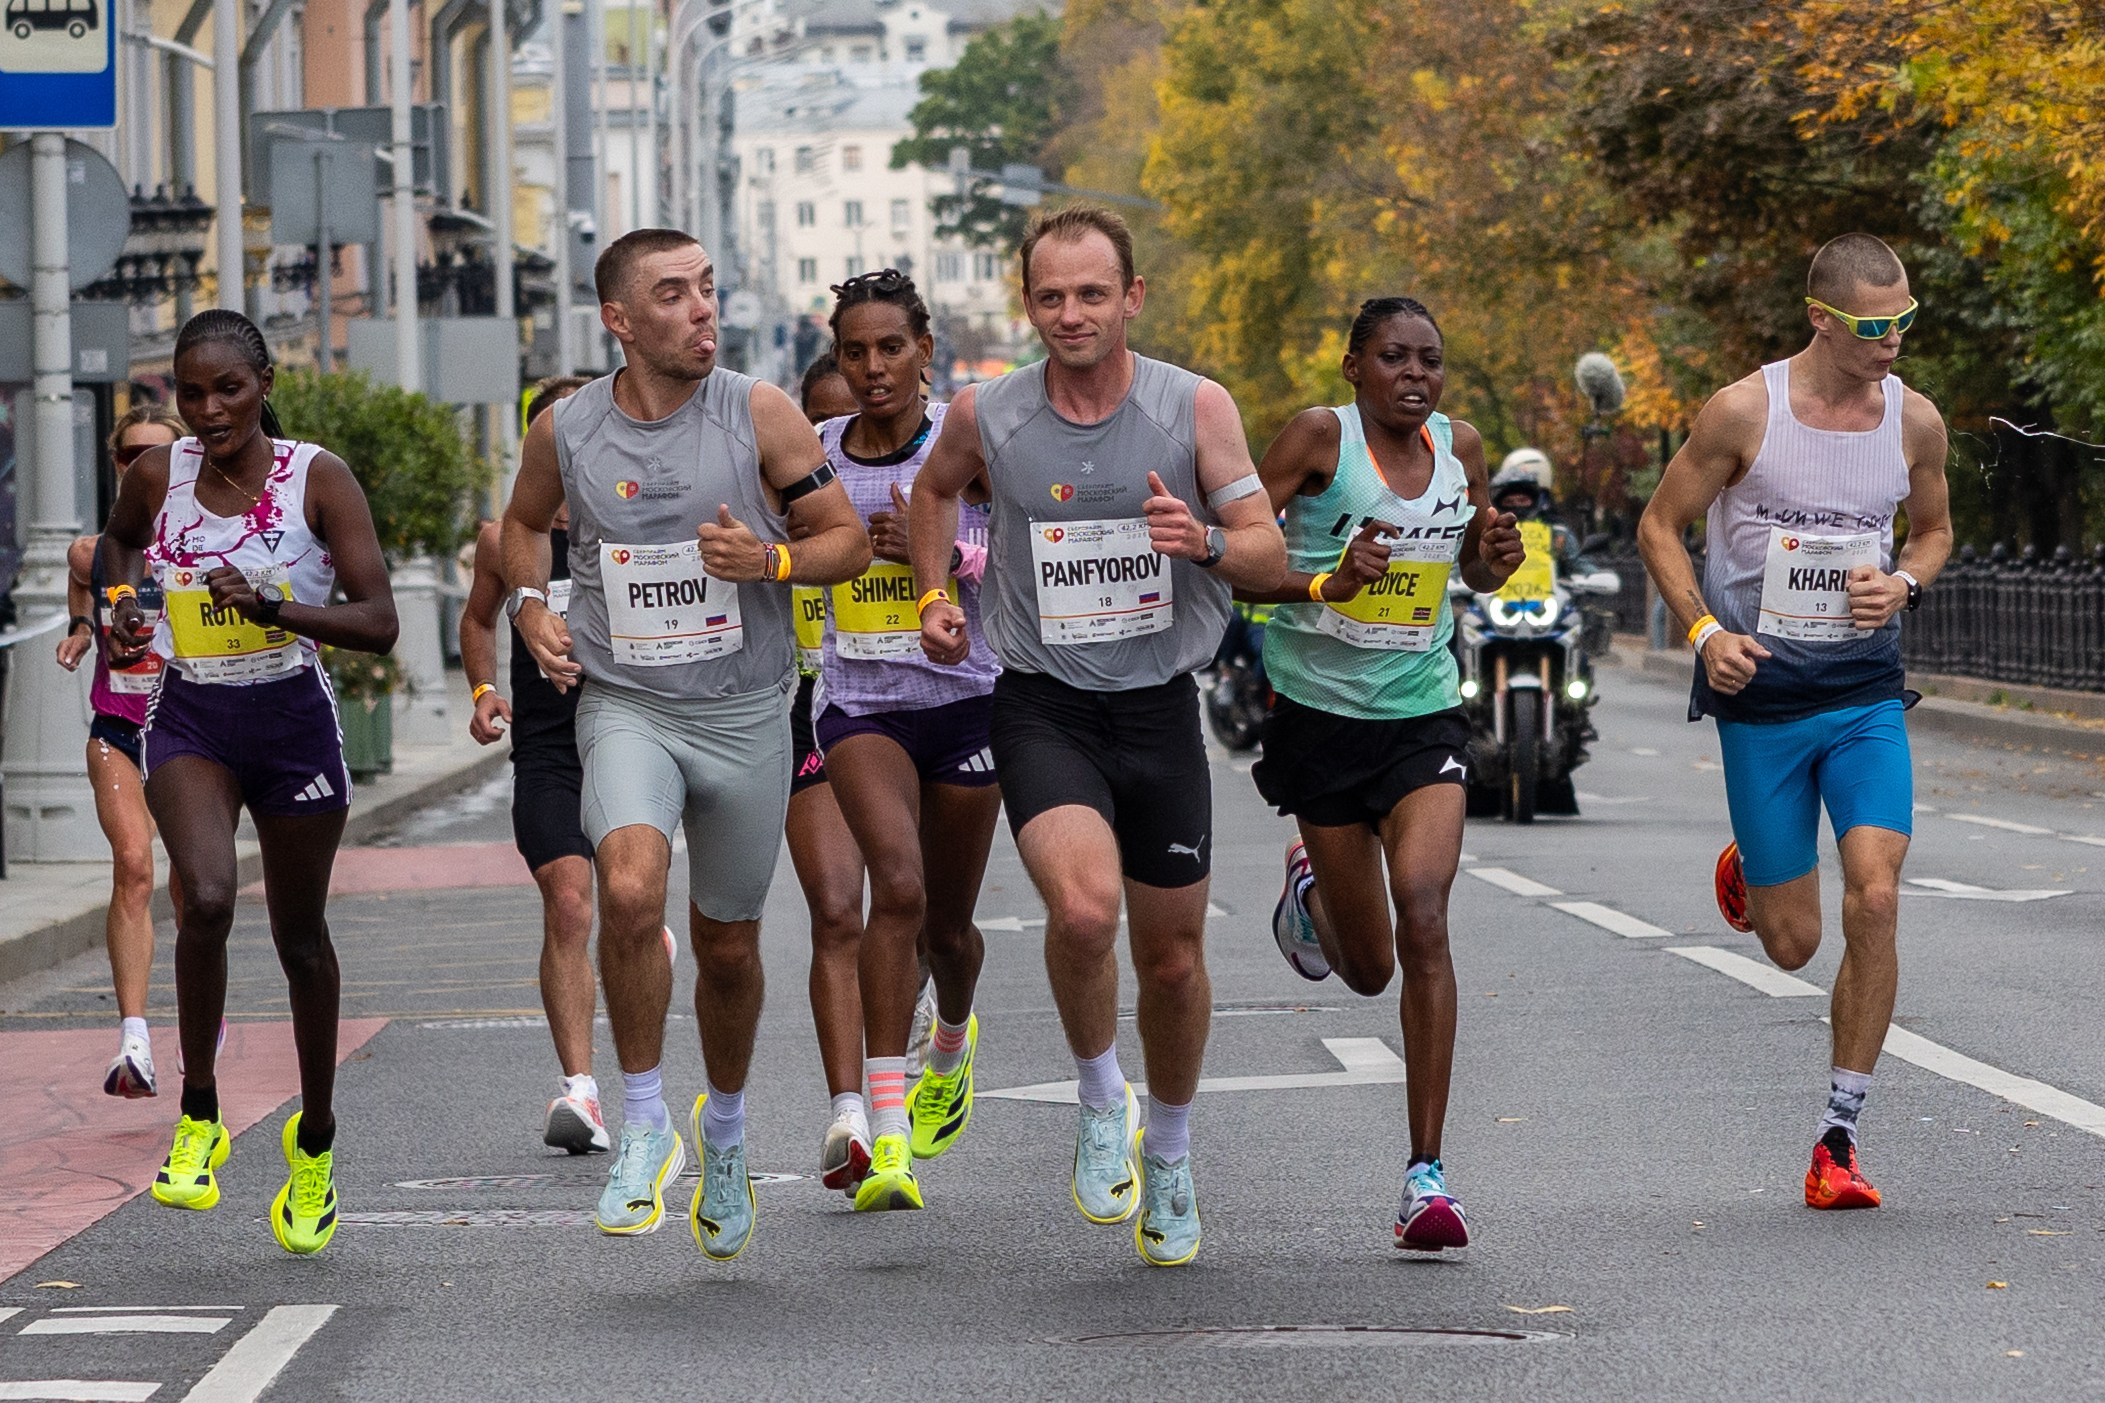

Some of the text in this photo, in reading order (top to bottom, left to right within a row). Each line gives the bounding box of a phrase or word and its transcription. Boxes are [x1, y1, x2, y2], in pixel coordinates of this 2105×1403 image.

[1814, 511, 1846, 527] WE
[1041, 553, 1161, 588] PANFYOROV
[1788, 567, 1850, 592] KHARI
[628, 577, 707, 608] PETROV
[1099, 597, 1112, 607] 18
[1378, 608, 1390, 617] 21
[1815, 603, 1828, 612] 13
[665, 619, 678, 629] 19
[886, 615, 900, 625] 22
[227, 639, 240, 649] 33
